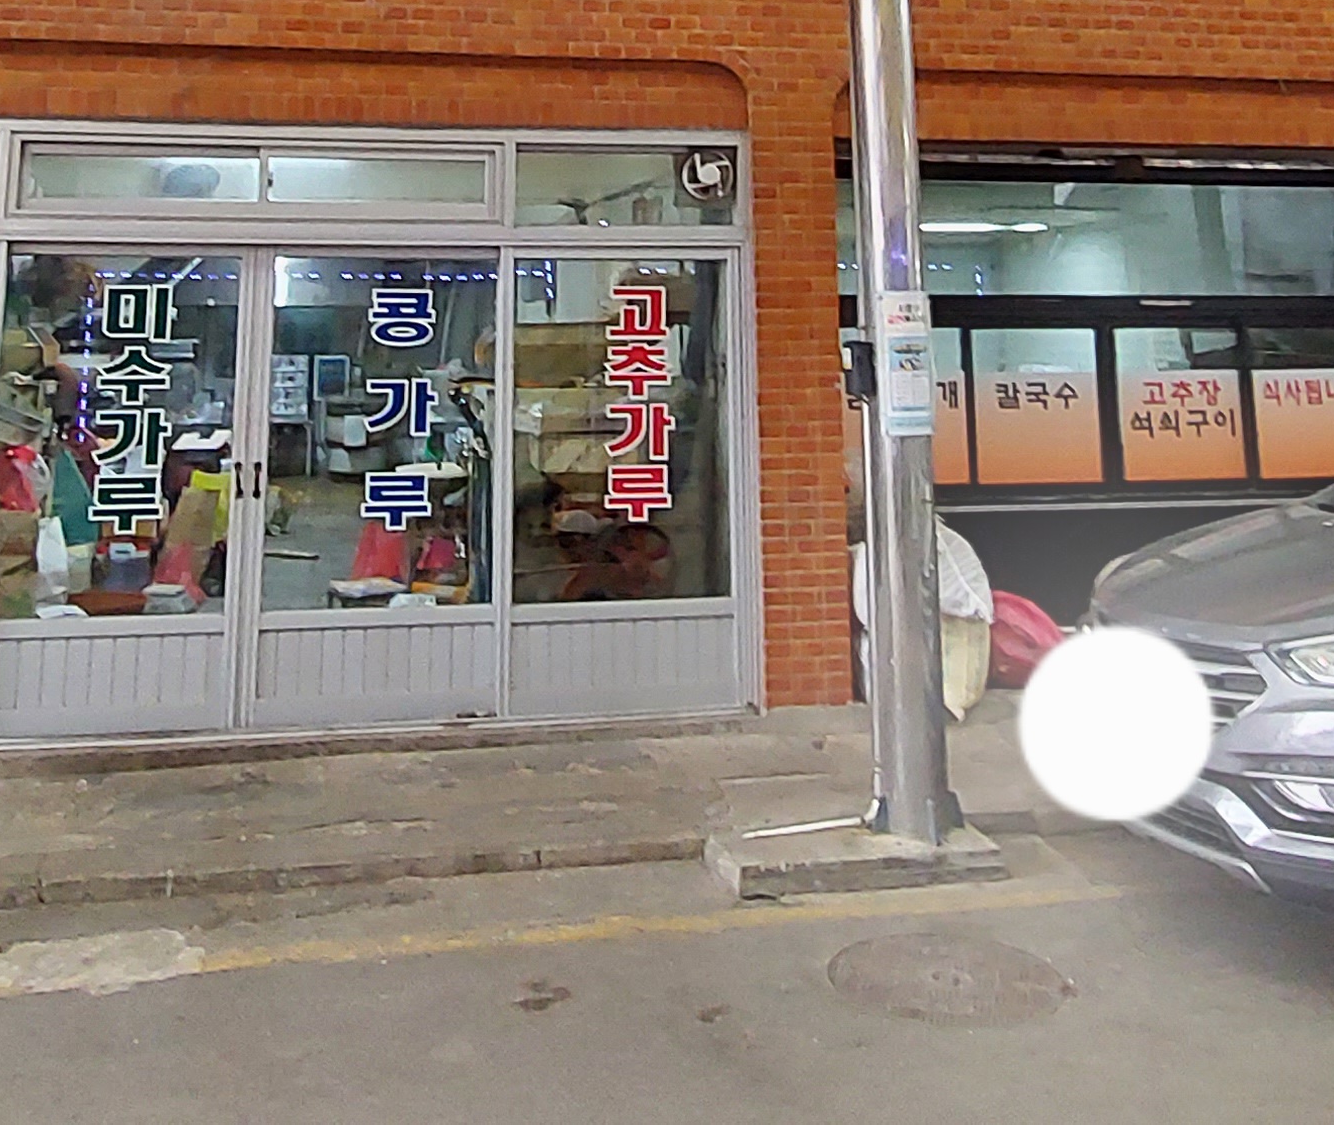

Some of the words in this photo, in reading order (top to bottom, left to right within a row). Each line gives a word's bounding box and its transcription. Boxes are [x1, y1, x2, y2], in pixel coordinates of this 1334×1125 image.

[88, 283, 178, 535] 미수가루
[361, 288, 438, 531] 콩가루
[605, 285, 675, 523] 고추가루
[995, 381, 1079, 410] 칼국수
[1142, 378, 1222, 407] 고추장
